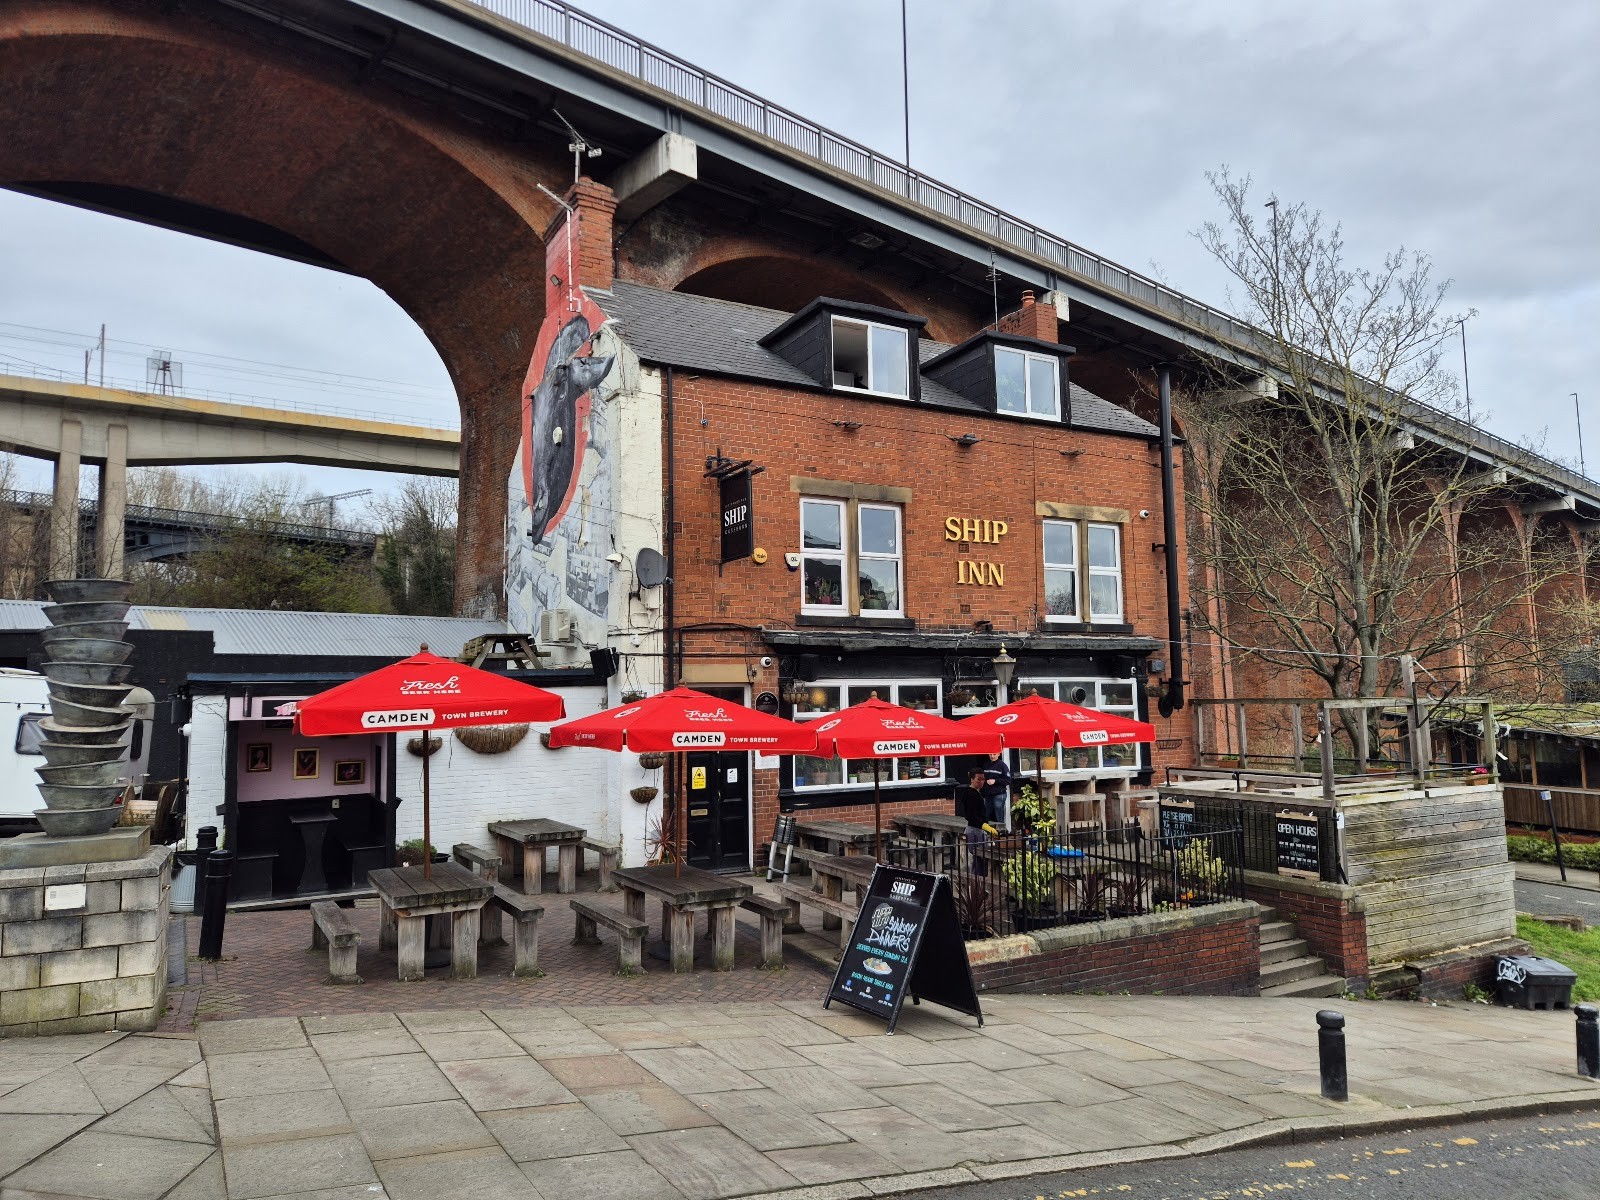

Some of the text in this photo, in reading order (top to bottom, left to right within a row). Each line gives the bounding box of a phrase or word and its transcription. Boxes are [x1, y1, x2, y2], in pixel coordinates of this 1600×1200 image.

[724, 505, 747, 527] SHIP
[945, 516, 1008, 544] SHIP
[956, 560, 1004, 587] INN
[400, 675, 459, 691] Fresh
[367, 709, 509, 724] CAMDEN TOWN BREWERY
[684, 707, 728, 718] Fresh
[676, 735, 721, 743] CAMDEN
[1083, 732, 1106, 741] CAMDEN
[876, 743, 916, 751] CAMDEN
[1277, 823, 1317, 837] OPEN HOURS
[890, 881, 916, 896] SHIP
[865, 928, 911, 953] DINNERS
